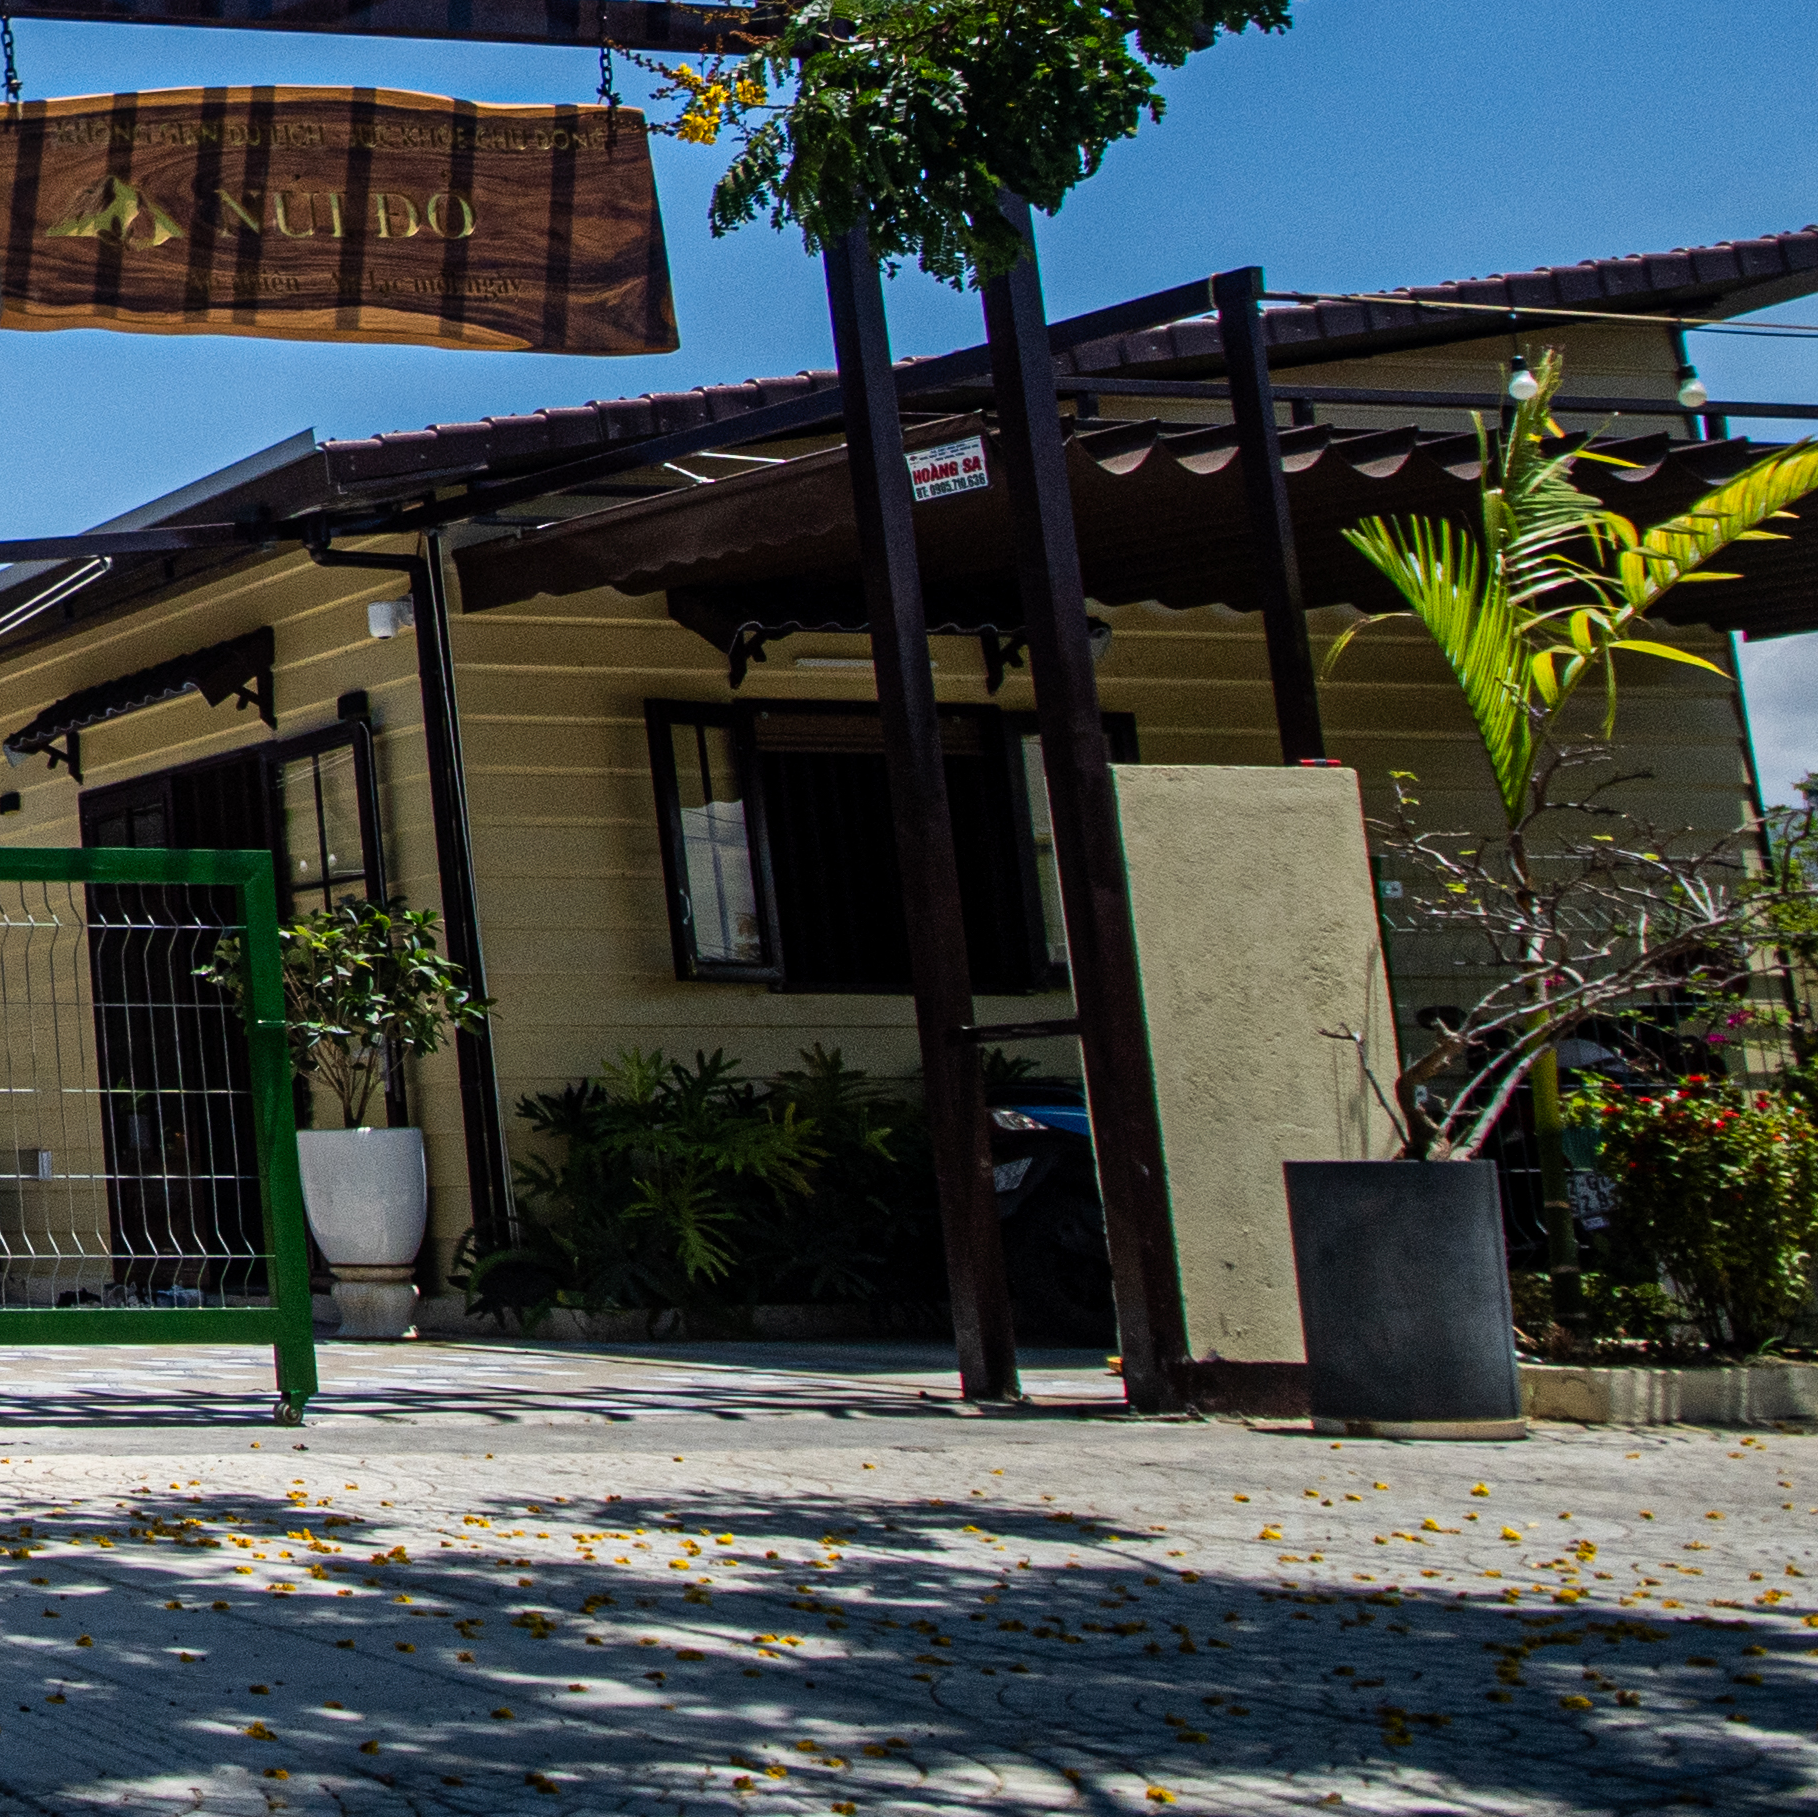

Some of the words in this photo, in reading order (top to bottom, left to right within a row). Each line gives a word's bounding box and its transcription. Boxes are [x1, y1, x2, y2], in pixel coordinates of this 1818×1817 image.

[214, 174, 348, 239] NÚI
[369, 170, 477, 240] ĐỎ
[912, 462, 960, 485] HOÀNG
[962, 455, 982, 473] SA
